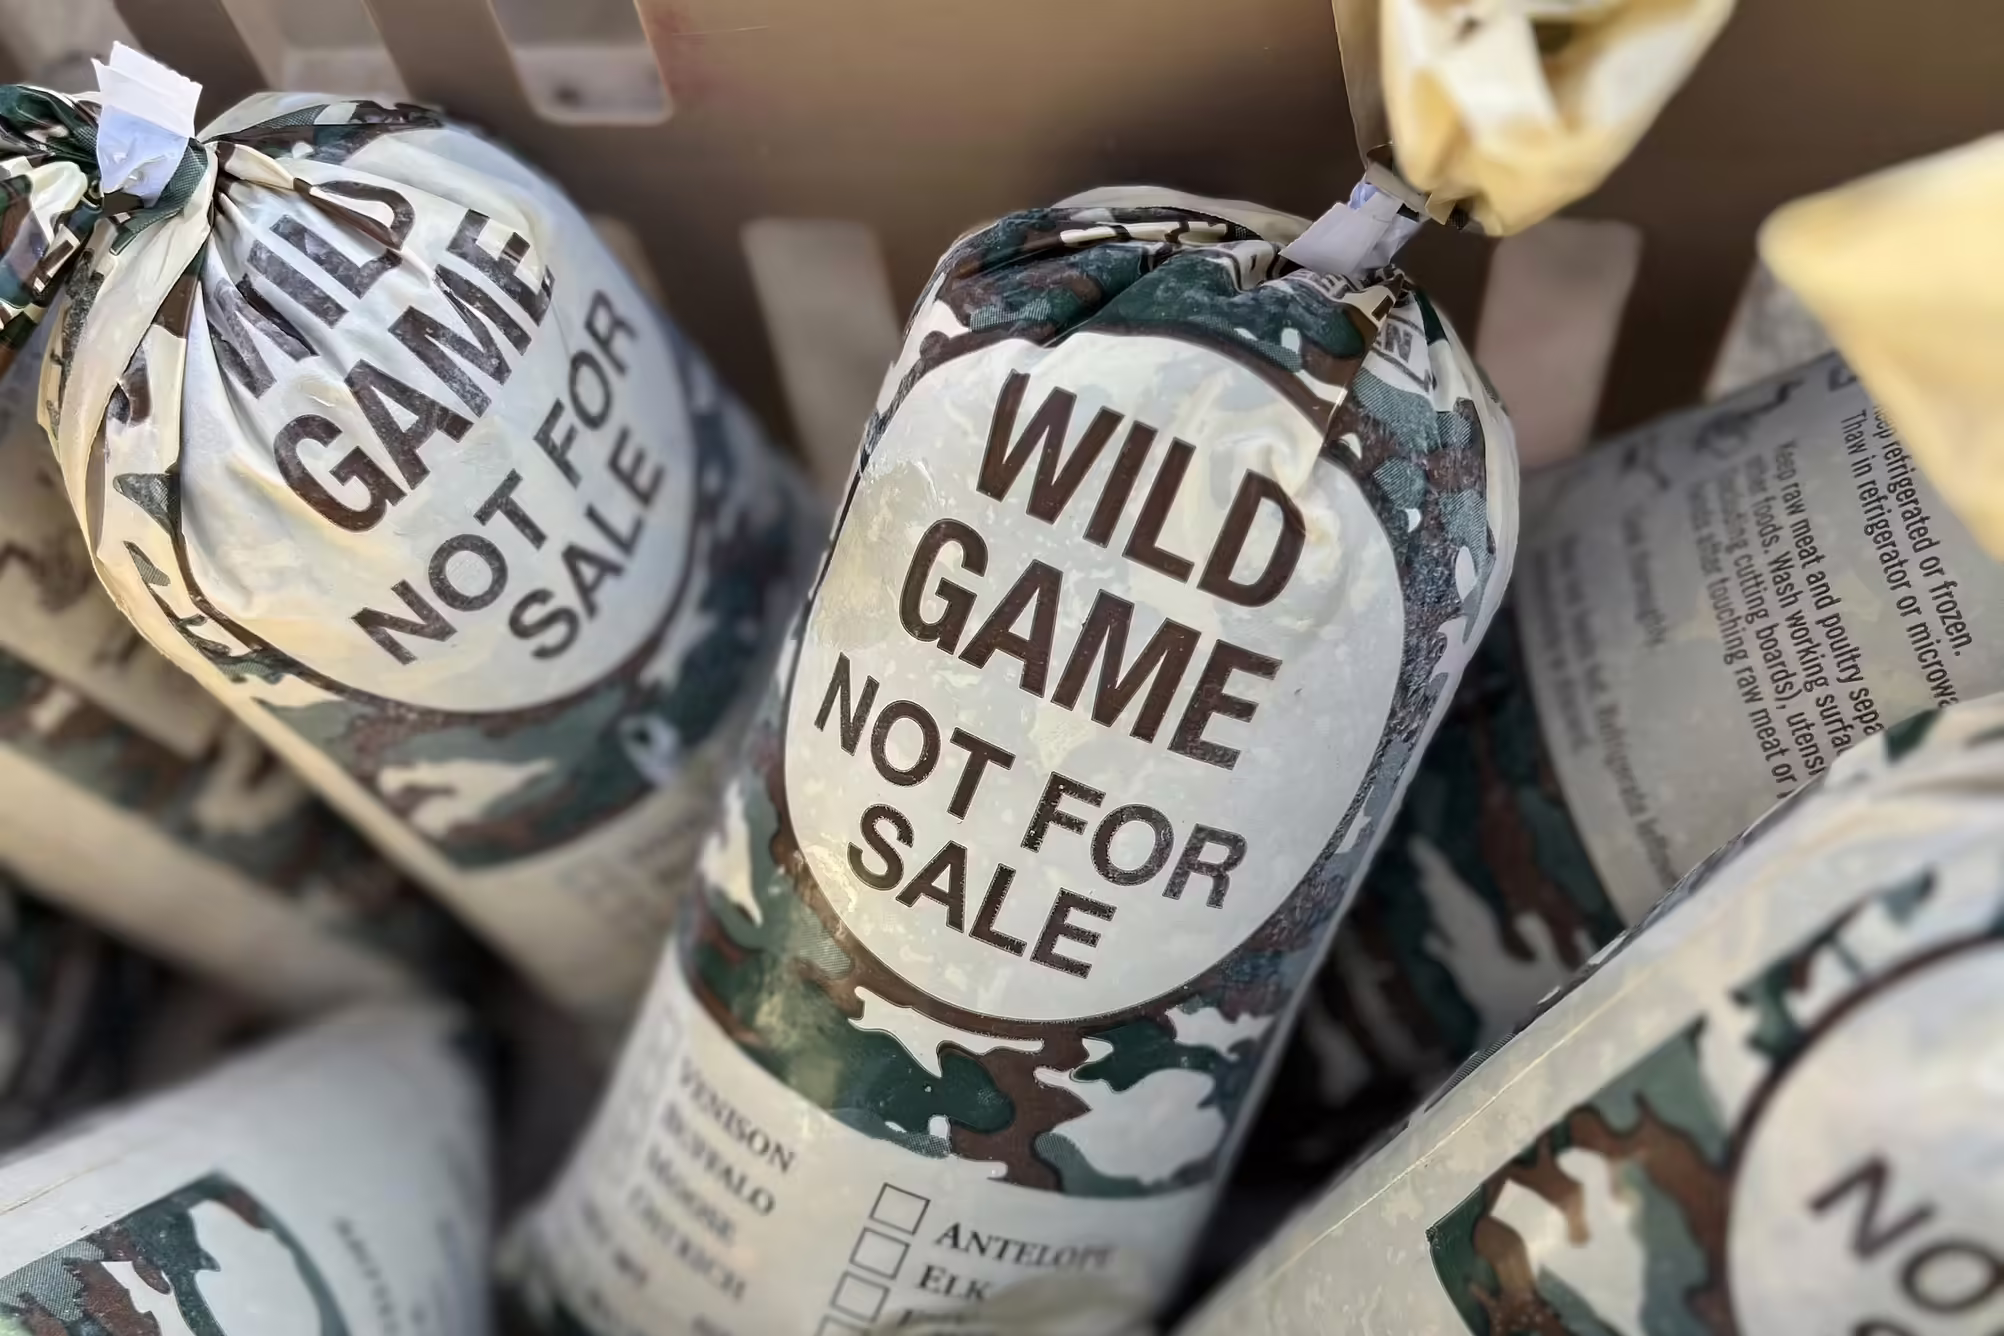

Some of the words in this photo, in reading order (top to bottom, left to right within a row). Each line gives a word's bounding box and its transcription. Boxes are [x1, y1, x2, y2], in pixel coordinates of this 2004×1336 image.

[273, 208, 556, 533] GAME
[1841, 409, 1868, 455] Thaw
[1850, 455, 1877, 478] in
[350, 469, 548, 665] NOT
[534, 289, 638, 488] FOR
[976, 368, 1307, 608] WILD
[1781, 482, 1807, 516] raw
[1882, 440, 1941, 553] refrigerated
[507, 426, 668, 660] SALE
[1751, 496, 1784, 554] foods.
[1790, 518, 1826, 569] meat
[1856, 479, 1912, 591] refrigerator
[1767, 551, 1804, 609] Wash
[1805, 571, 1842, 610] and
[1918, 556, 1945, 577] or
[1707, 576, 1749, 665] touching
[1733, 553, 1769, 624] cutting
[1755, 623, 1803, 710] boards),
[1896, 595, 1922, 617] or
[1928, 580, 1973, 657] frozen.
[899, 517, 1283, 771] GAME
[1785, 609, 1830, 692] working
[1815, 612, 1864, 684] poultry
[1735, 666, 1763, 704] raw
[1748, 708, 1790, 762] meat
[813, 651, 1015, 824] NOT
[1020, 771, 1248, 909] FOR
[1771, 763, 1797, 783] or
[846, 803, 1118, 979] SALE
[680, 1056, 795, 1174] VENISON
[917, 1264, 992, 1301] ELK
